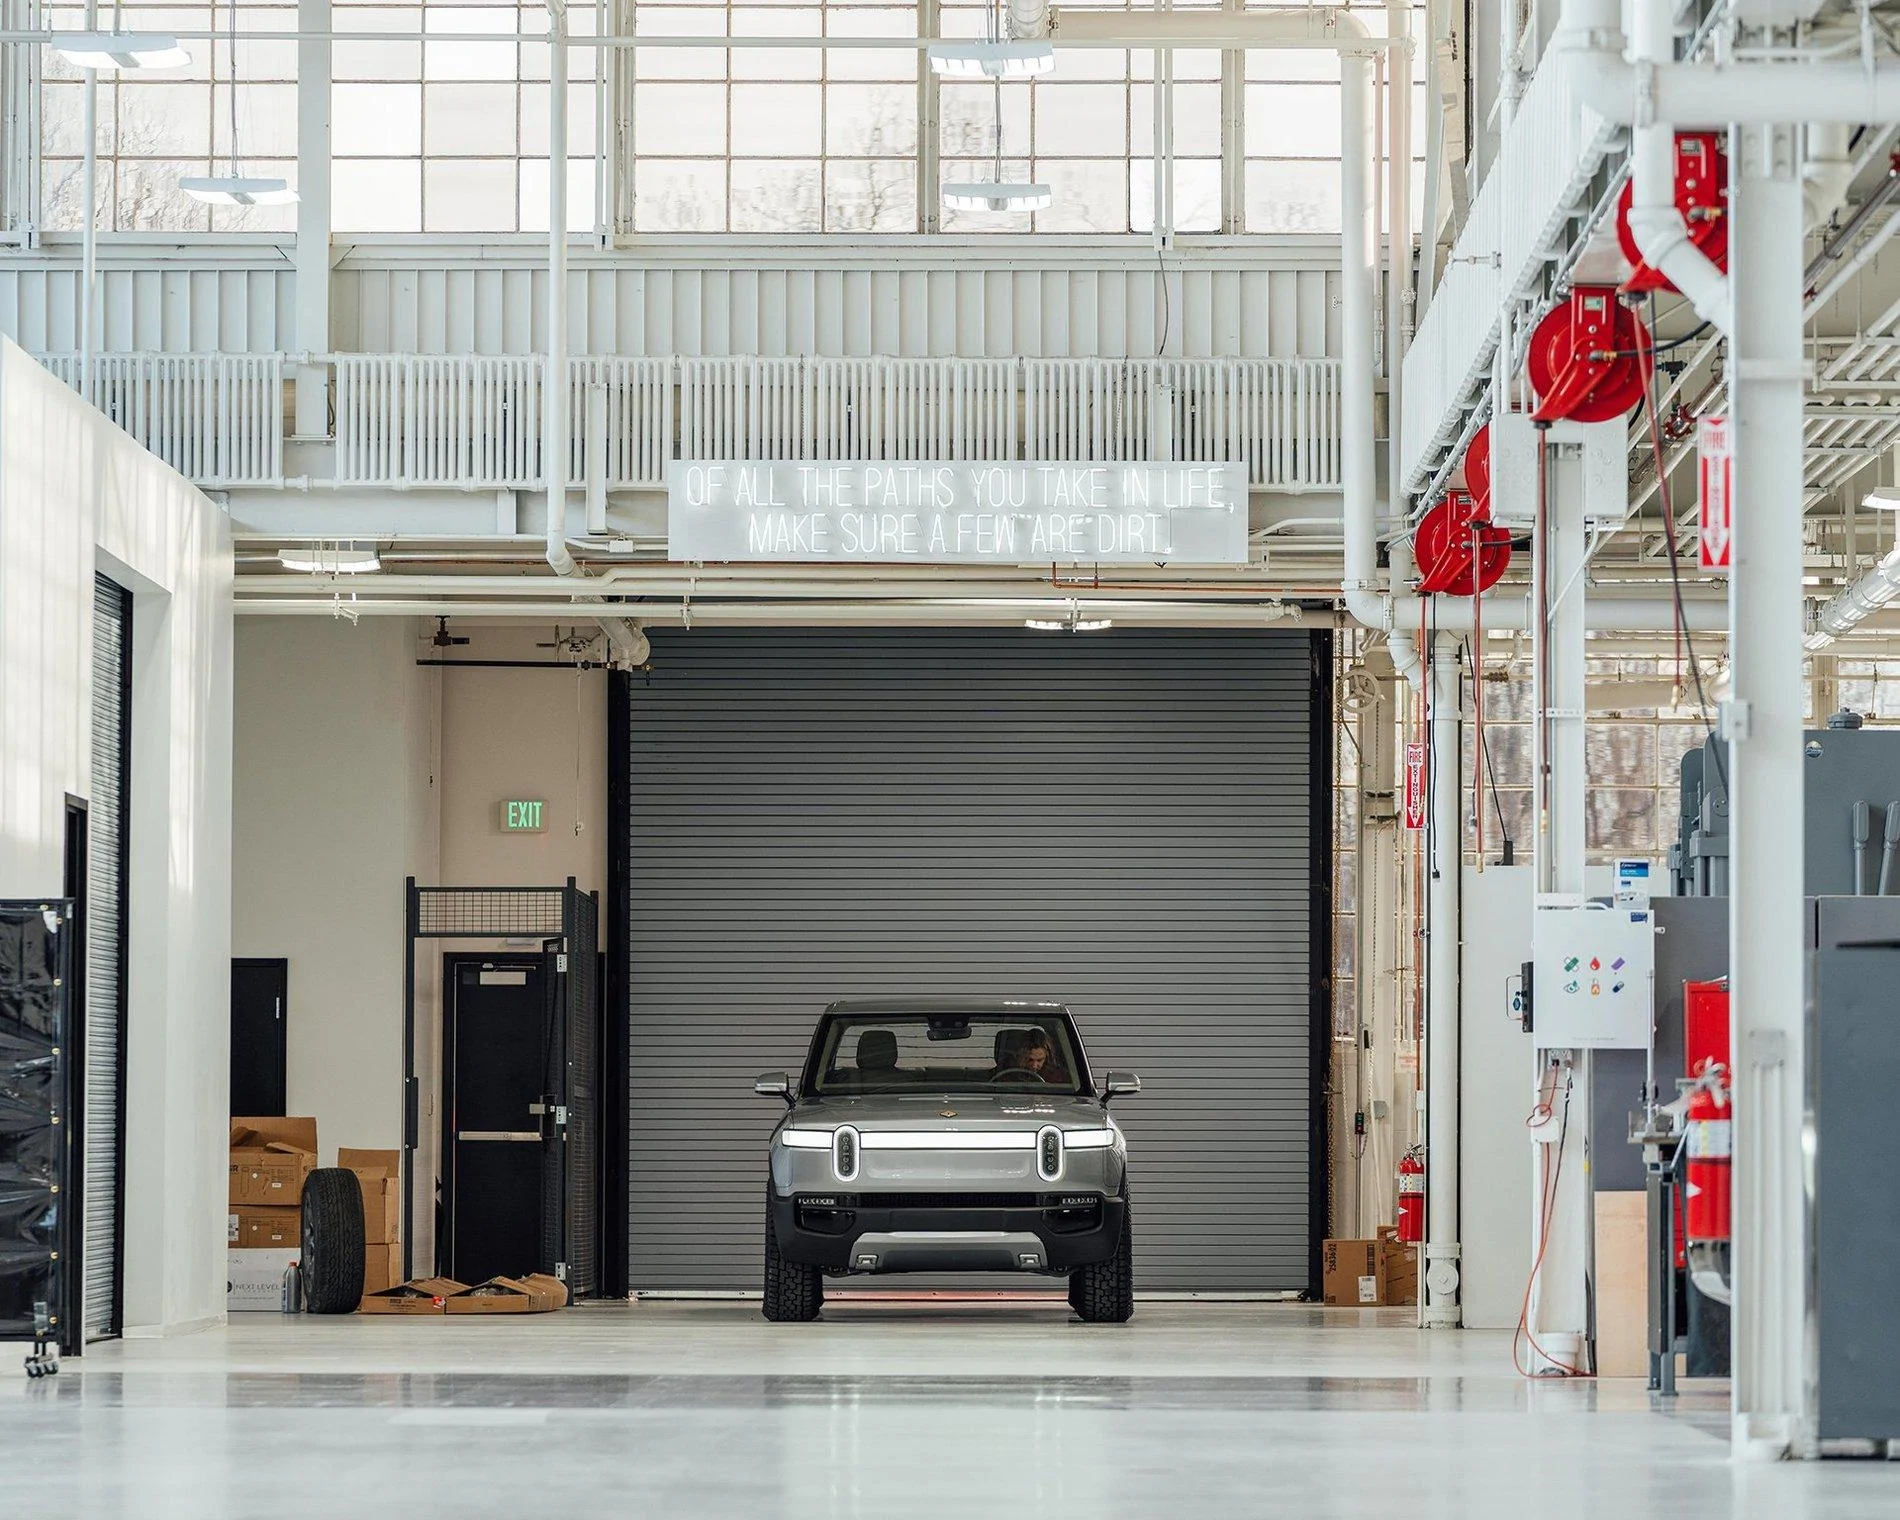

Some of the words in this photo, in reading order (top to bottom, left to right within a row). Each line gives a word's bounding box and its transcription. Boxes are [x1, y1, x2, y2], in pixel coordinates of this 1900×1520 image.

[686, 466, 725, 506] OF
[736, 466, 786, 506] ALL
[797, 467, 853, 507] THE
[864, 467, 954, 508] PATHS
[971, 467, 1026, 508] YOU
[1037, 467, 1107, 507] TAKE
[1122, 467, 1150, 507] IN
[1163, 467, 1234, 513] LIFE,
[748, 512, 828, 554] MAKE
[840, 512, 918, 553] SURE
[929, 513, 947, 553] A
[957, 513, 1016, 553] FEW
[1031, 513, 1086, 553] ARE
[1409, 751, 1422, 763] FIRE
[508, 801, 542, 828] EXIT
[235, 1283, 255, 1291] NEXT
[256, 1283, 280, 1291] LEVEL
